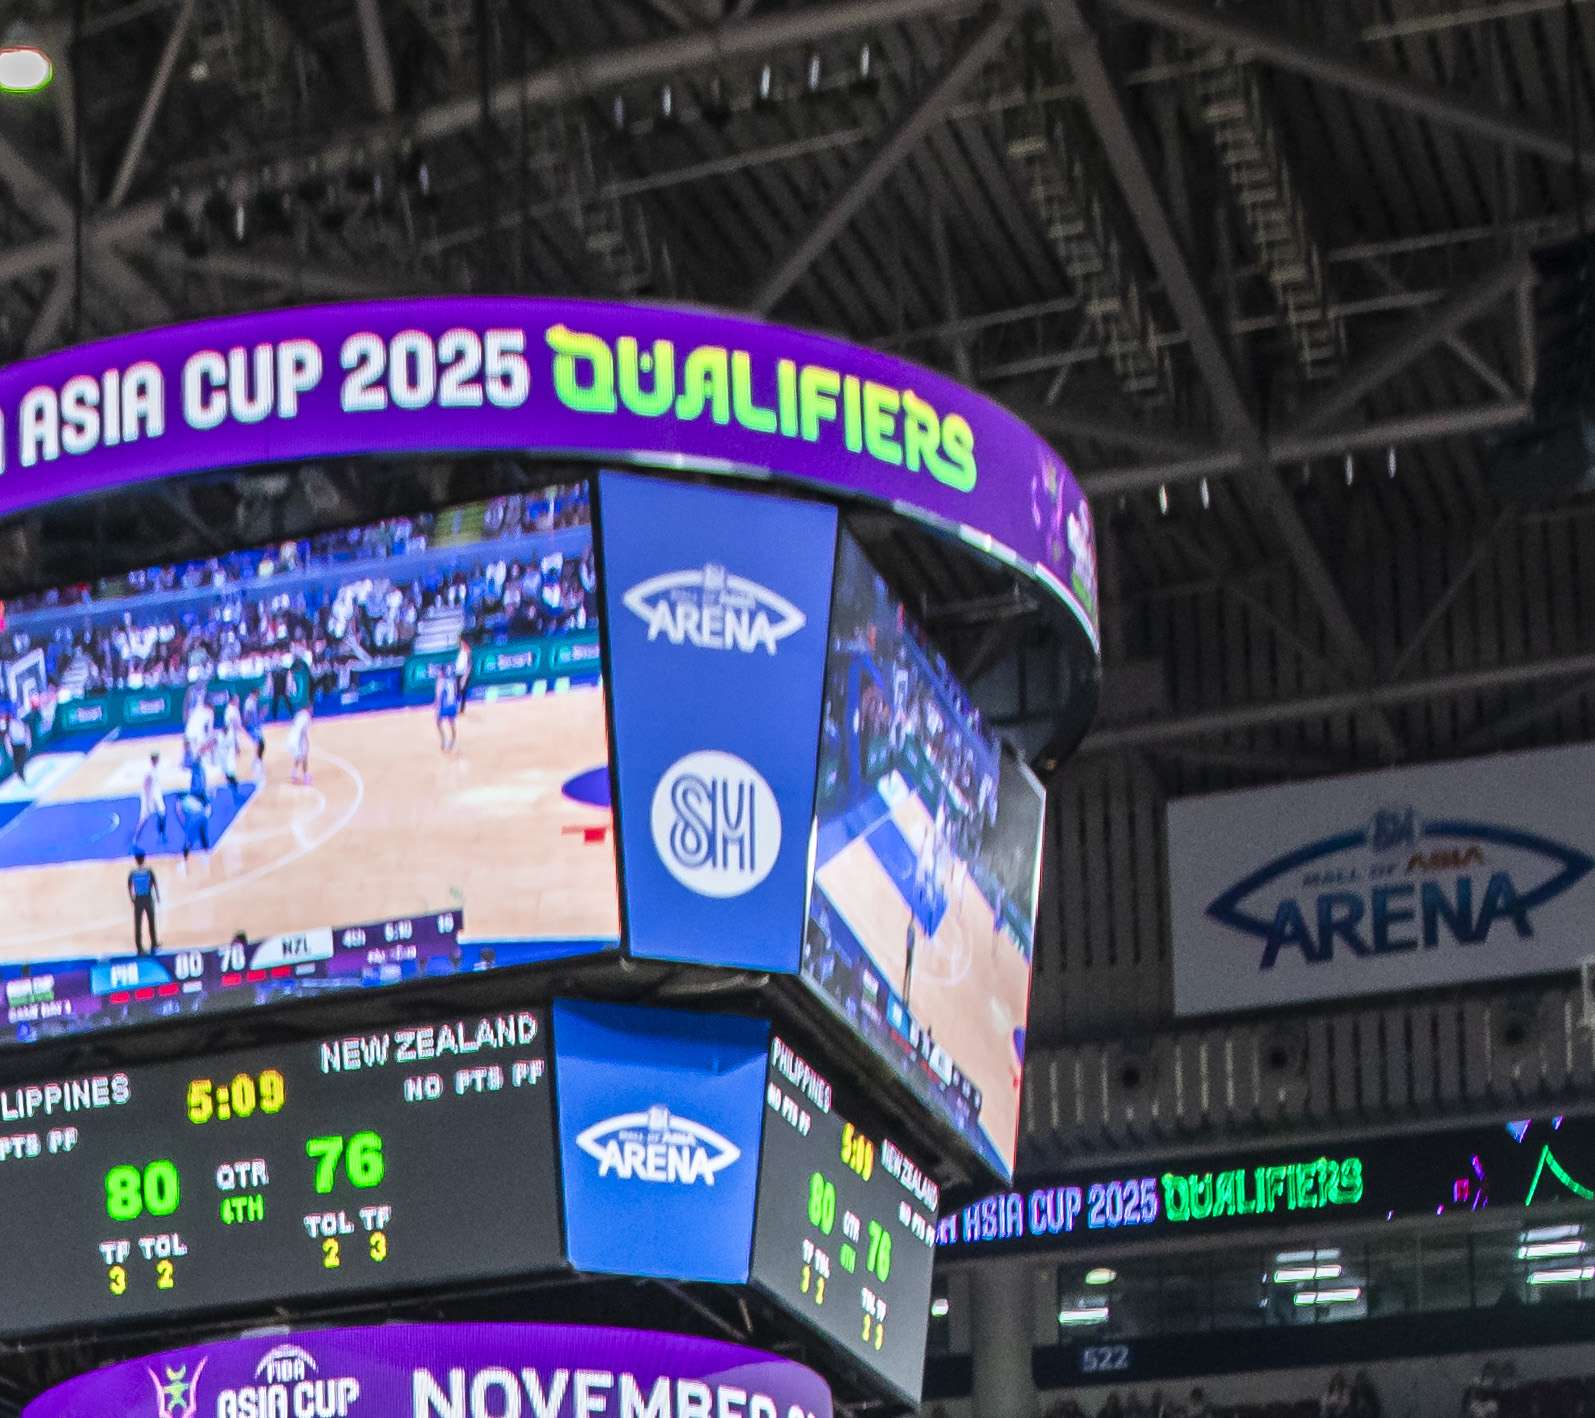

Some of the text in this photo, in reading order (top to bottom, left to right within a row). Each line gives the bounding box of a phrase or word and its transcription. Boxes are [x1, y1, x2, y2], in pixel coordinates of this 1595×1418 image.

[19, 353, 165, 469] ASIA
[180, 337, 324, 430] CUP
[340, 326, 530, 414] 2025
[544, 322, 980, 495] QUALIFIERS
[646, 598, 778, 656] ARENA
[669, 773, 757, 873] SM
[1258, 868, 1536, 972] ARENA
[321, 1012, 538, 1074] NEW ZEALAND
[186, 1068, 285, 1125] 5:09
[403, 1072, 443, 1102] NO
[770, 1035, 833, 1115] PHILIPPINES
[105, 1159, 180, 1222] 80
[305, 1131, 385, 1194] 76
[595, 1139, 718, 1187] ARENA
[1027, 1186, 1084, 1234] CUP
[1085, 1176, 1160, 1230] 2025
[1160, 1154, 1364, 1223] QUALIFIERS
[808, 1171, 836, 1236] 80
[108, 1258, 175, 1296] 3 2
[322, 1231, 388, 1269] 2 3
